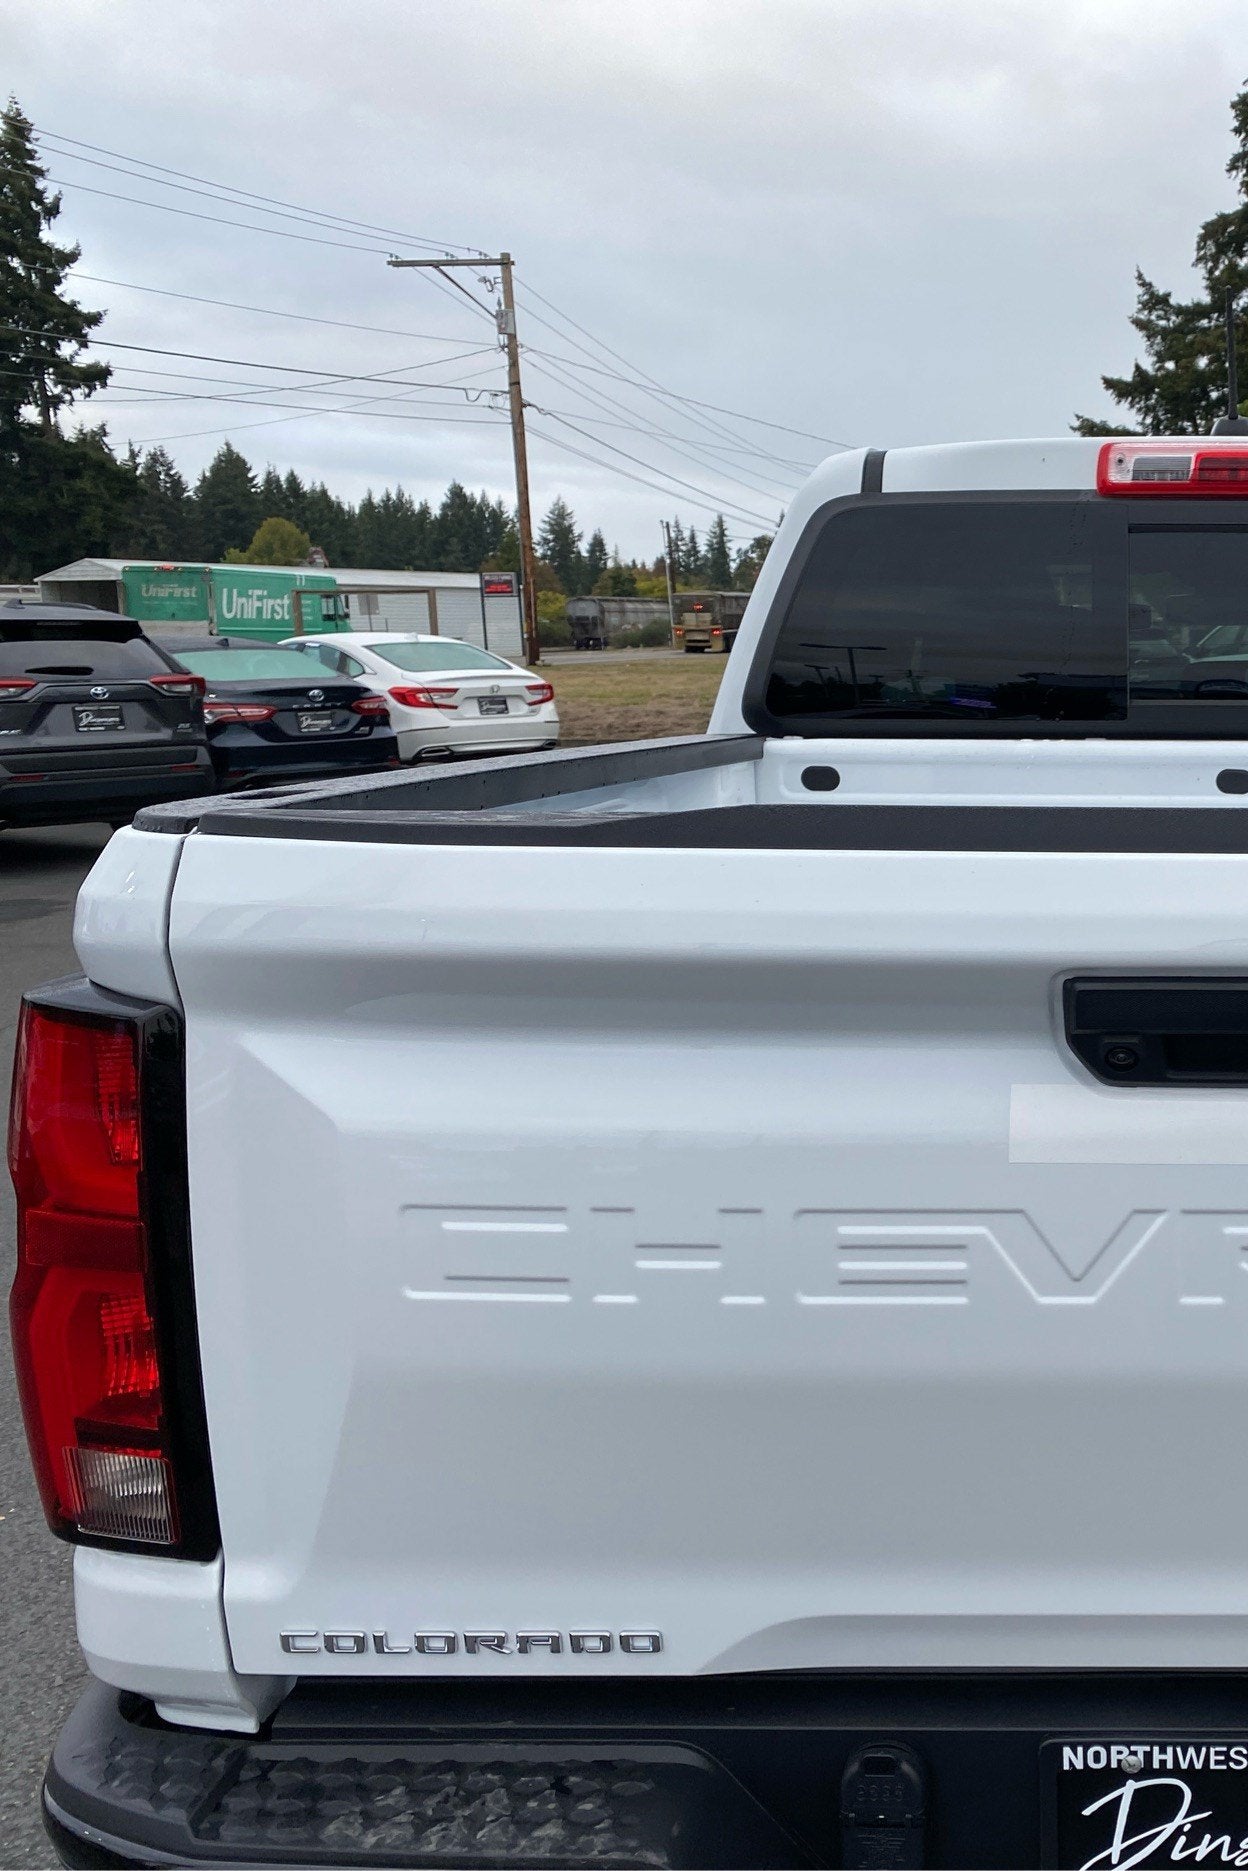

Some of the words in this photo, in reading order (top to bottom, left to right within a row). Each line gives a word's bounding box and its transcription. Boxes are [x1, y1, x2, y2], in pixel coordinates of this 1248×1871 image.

[141, 584, 198, 598] UniFirst
[222, 588, 290, 620] UniFirst
[279, 1629, 664, 1655] COLORADO
